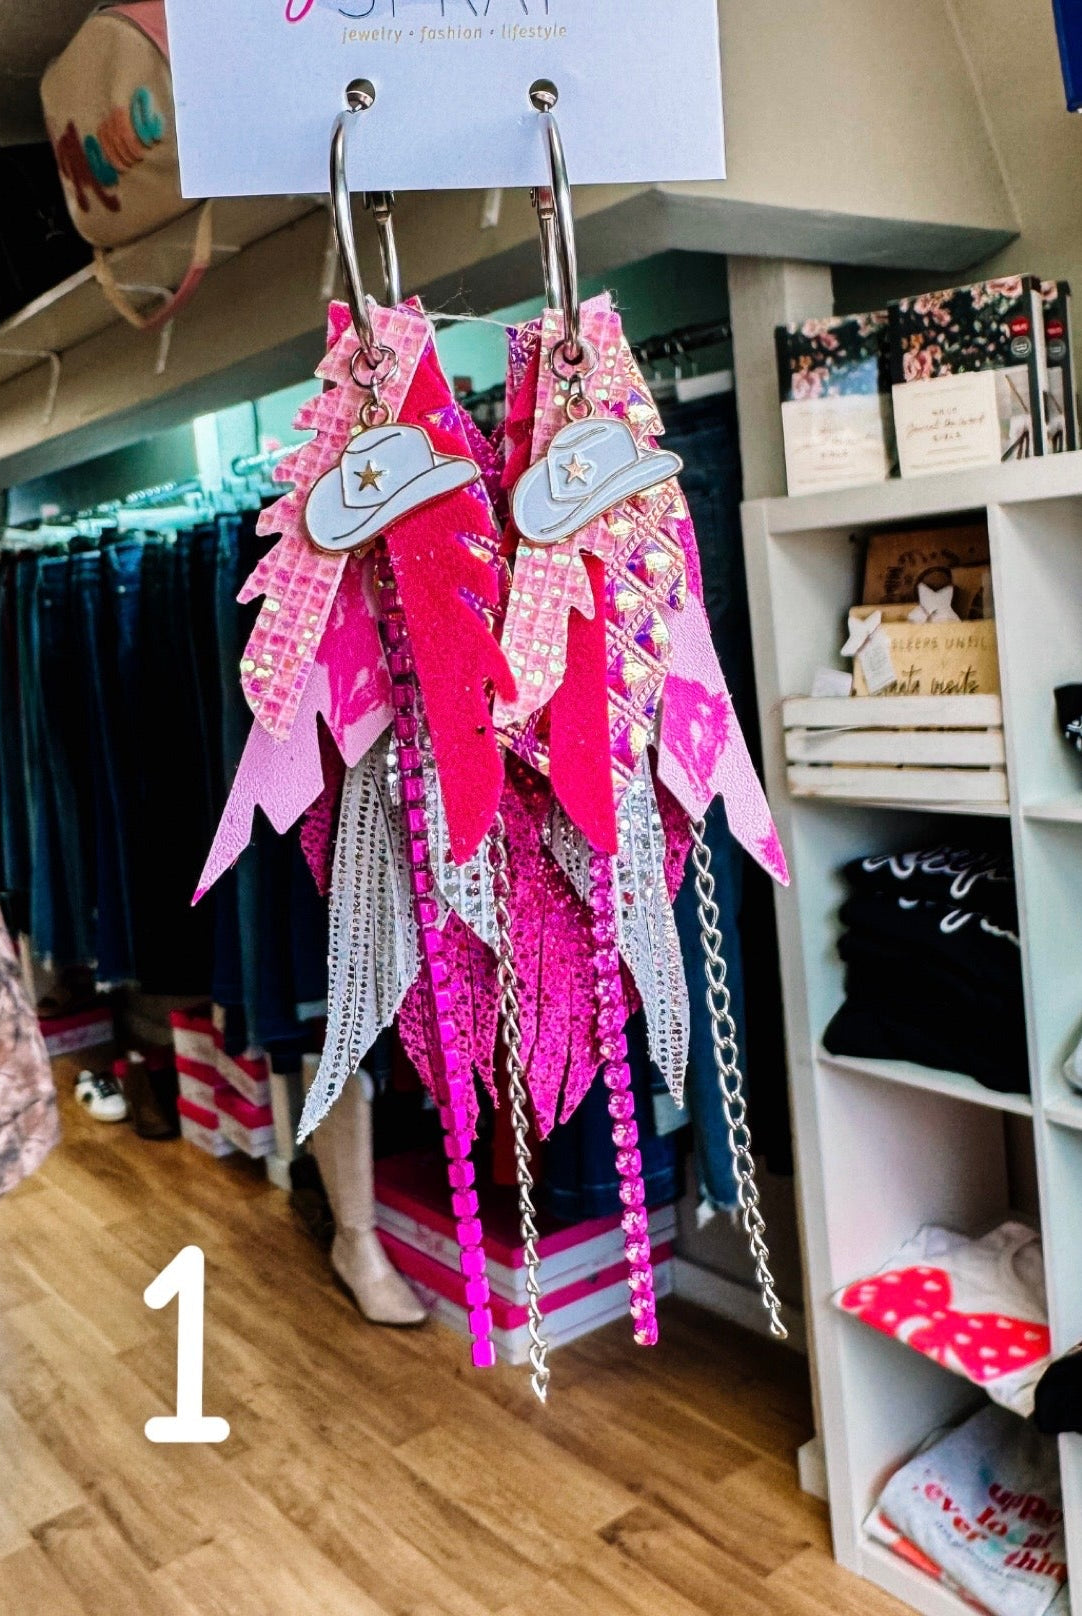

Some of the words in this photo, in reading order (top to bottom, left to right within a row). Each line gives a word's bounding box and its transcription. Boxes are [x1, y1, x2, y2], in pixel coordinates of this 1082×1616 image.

[342, 26, 402, 44] jewelry
[420, 26, 482, 43] fashion
[501, 22, 567, 41] lifestyle
[876, 664, 922, 696] anta
